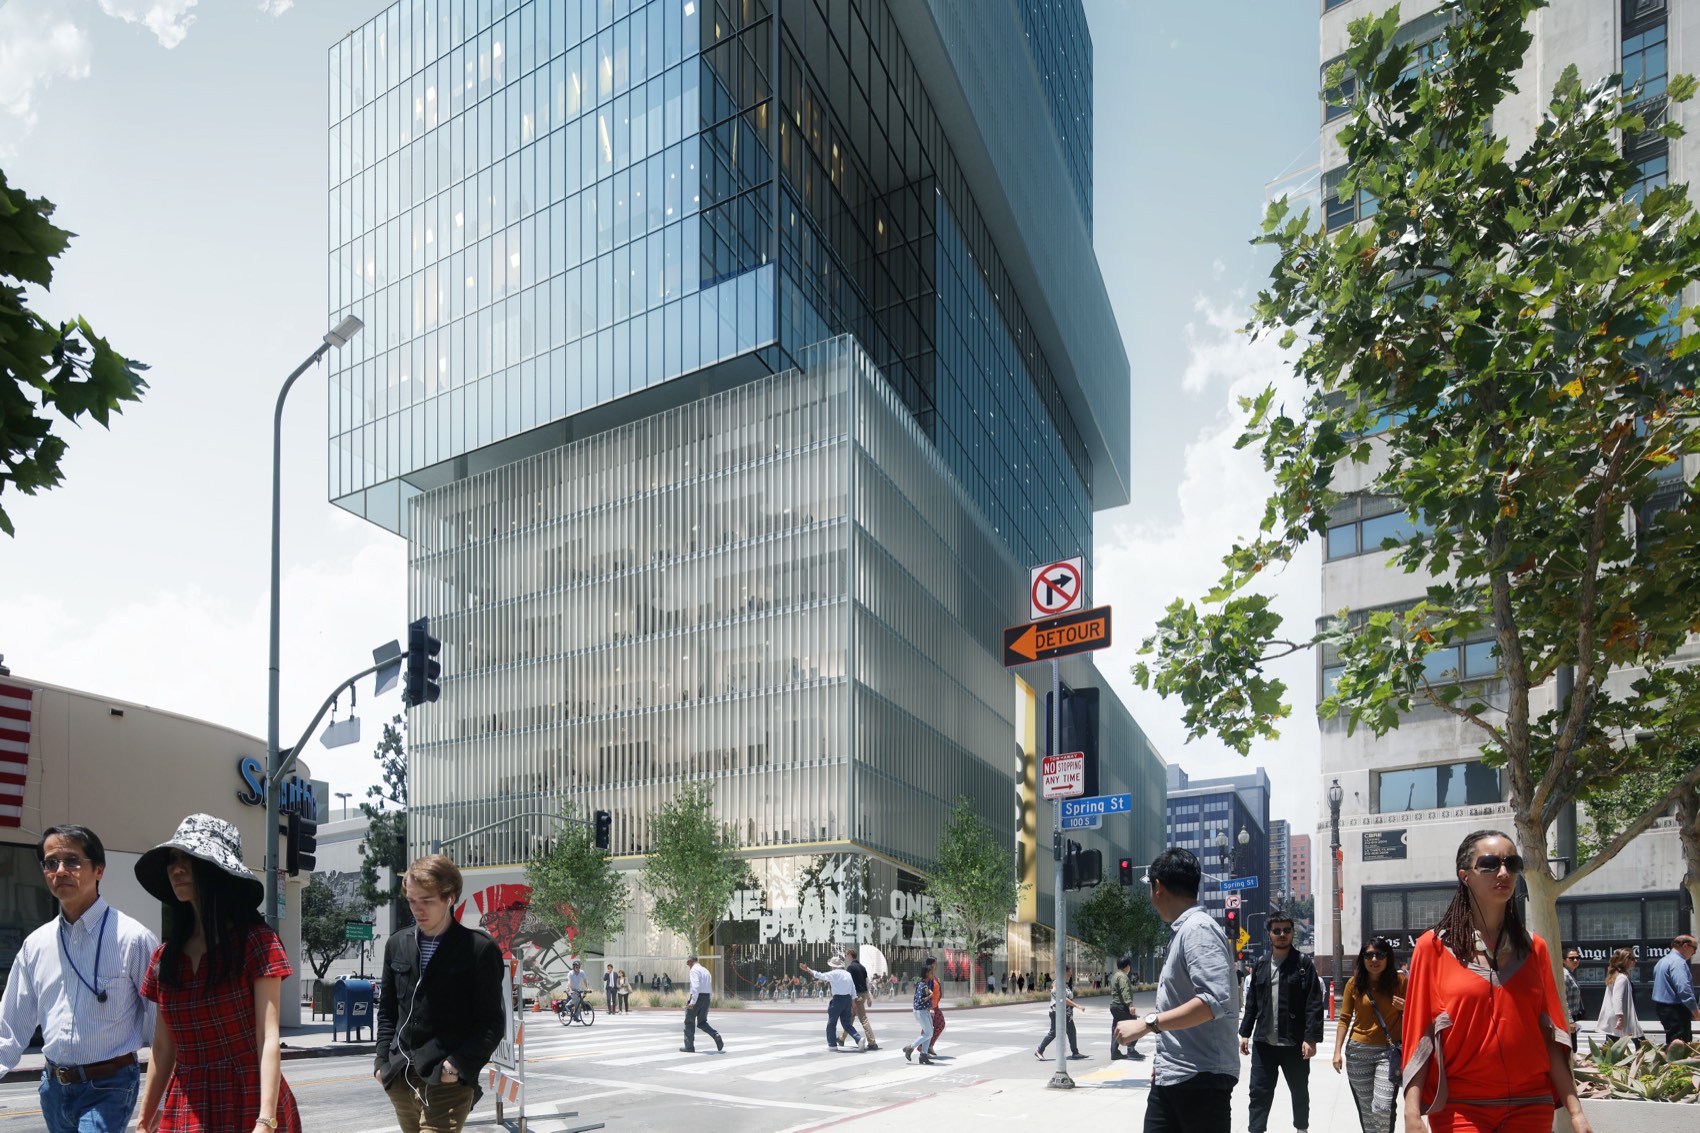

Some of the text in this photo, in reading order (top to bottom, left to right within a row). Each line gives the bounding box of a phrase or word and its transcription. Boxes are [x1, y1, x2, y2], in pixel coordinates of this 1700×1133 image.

[1036, 622, 1100, 649] DETOUR
[1044, 760, 1082, 775] NO STOPPING
[1045, 772, 1081, 785] ANY TIME
[1065, 797, 1124, 816] Spring St
[1070, 817, 1090, 827] 100 S
[759, 914, 875, 945] POWER
[1632, 945, 1672, 959] Time
